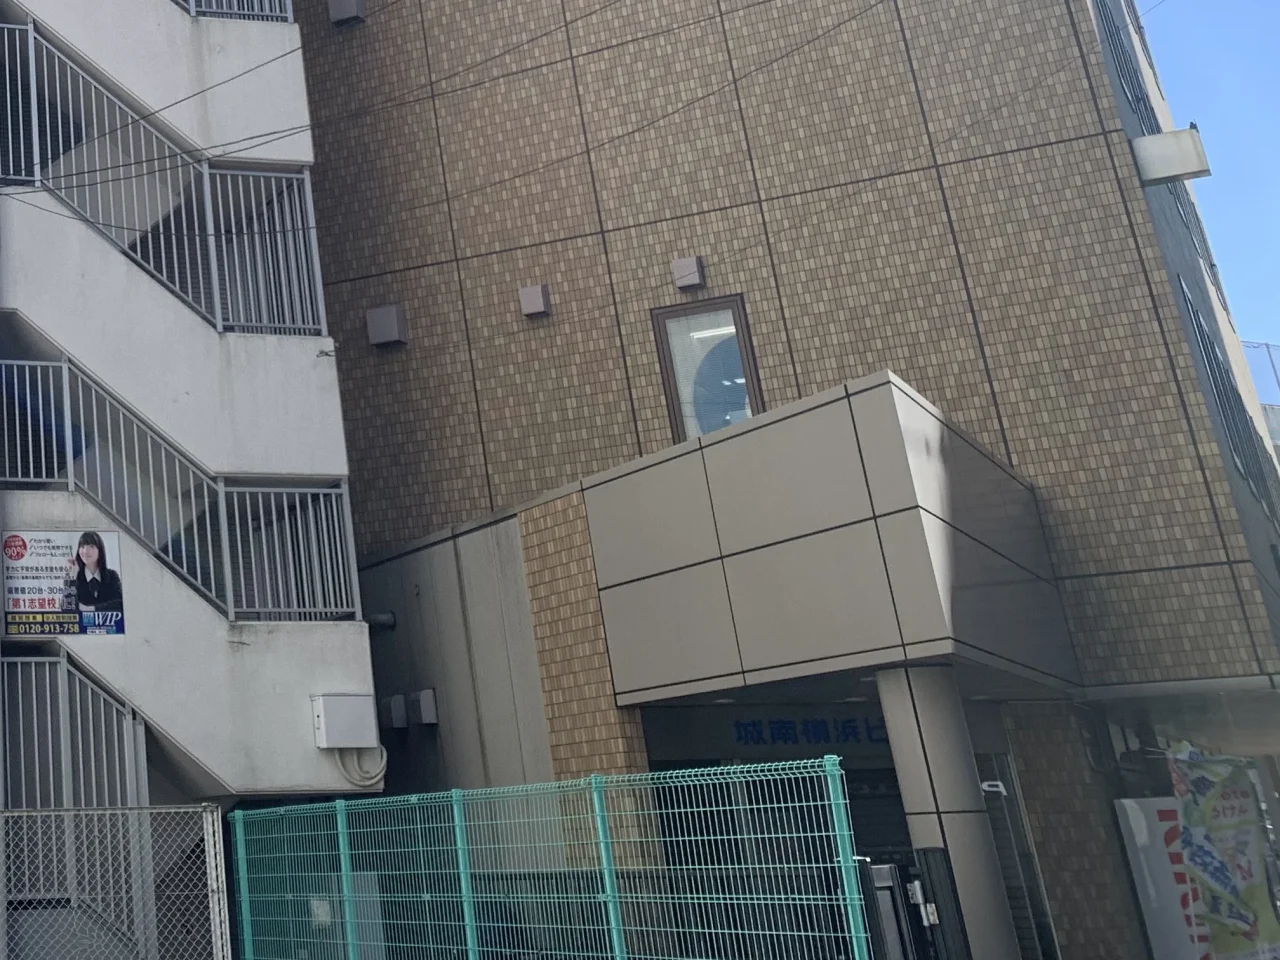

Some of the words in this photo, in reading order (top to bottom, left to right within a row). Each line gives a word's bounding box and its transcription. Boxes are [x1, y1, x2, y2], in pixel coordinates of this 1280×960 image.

[5, 546, 26, 557] 90%
[94, 611, 122, 626] WIP
[19, 624, 79, 633] 0120-913-758
